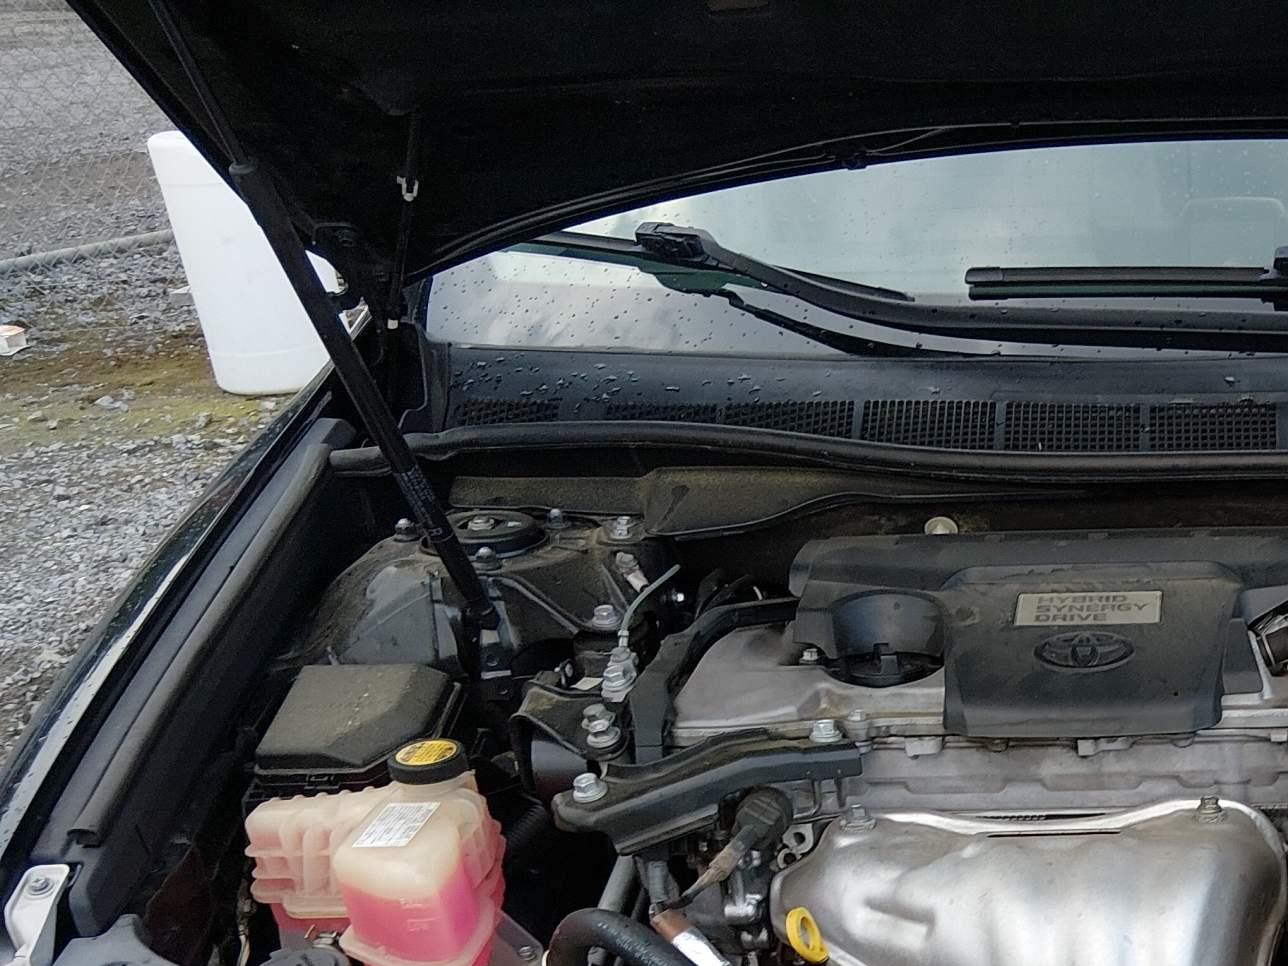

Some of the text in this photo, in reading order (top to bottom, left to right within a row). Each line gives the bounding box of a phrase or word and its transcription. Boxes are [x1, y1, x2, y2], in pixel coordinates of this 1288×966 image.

[1037, 595, 1128, 604] HYBRID
[1035, 603, 1148, 613] SYNERGY
[1033, 613, 1107, 622] DRIVE
